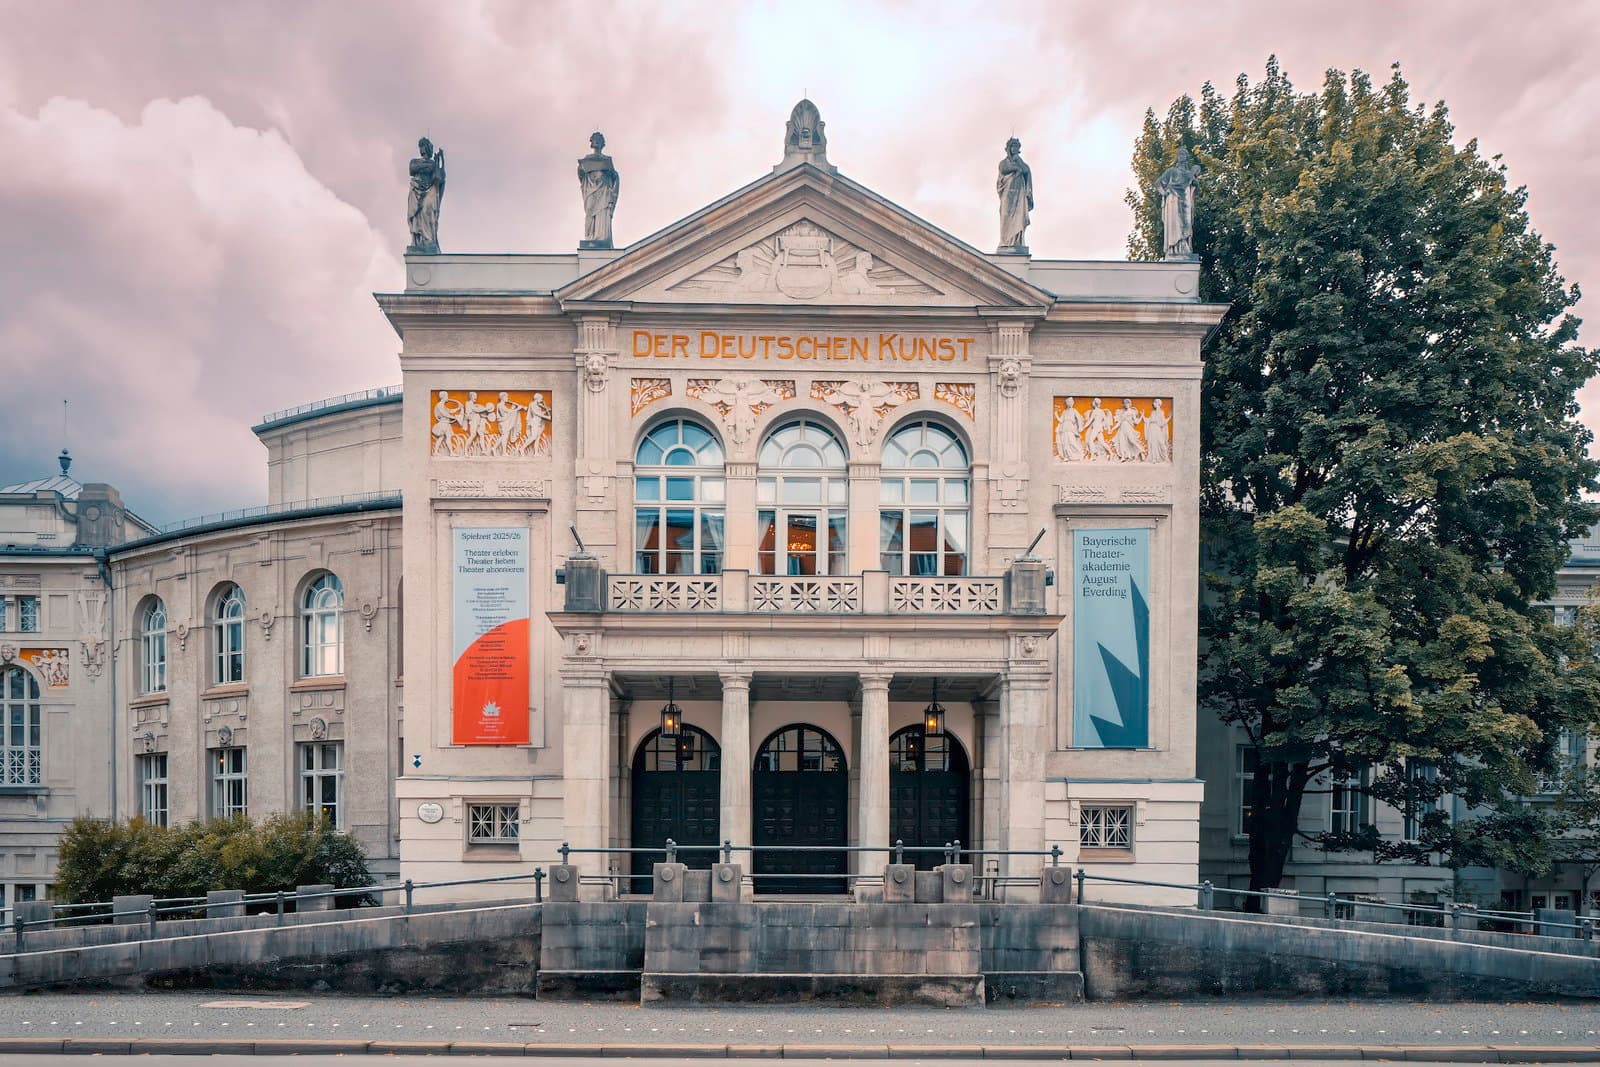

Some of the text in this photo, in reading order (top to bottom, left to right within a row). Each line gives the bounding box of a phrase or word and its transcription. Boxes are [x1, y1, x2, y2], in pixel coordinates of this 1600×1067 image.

[633, 331, 976, 361] DER DEUTSCHEN KUNST
[461, 532, 521, 541] Spielzeit 2025/26
[1082, 536, 1137, 548] Bayerische
[1082, 549, 1125, 558] Theater-
[1082, 561, 1131, 571] akademie
[1082, 574, 1118, 586] August
[1082, 587, 1127, 599] Everding
